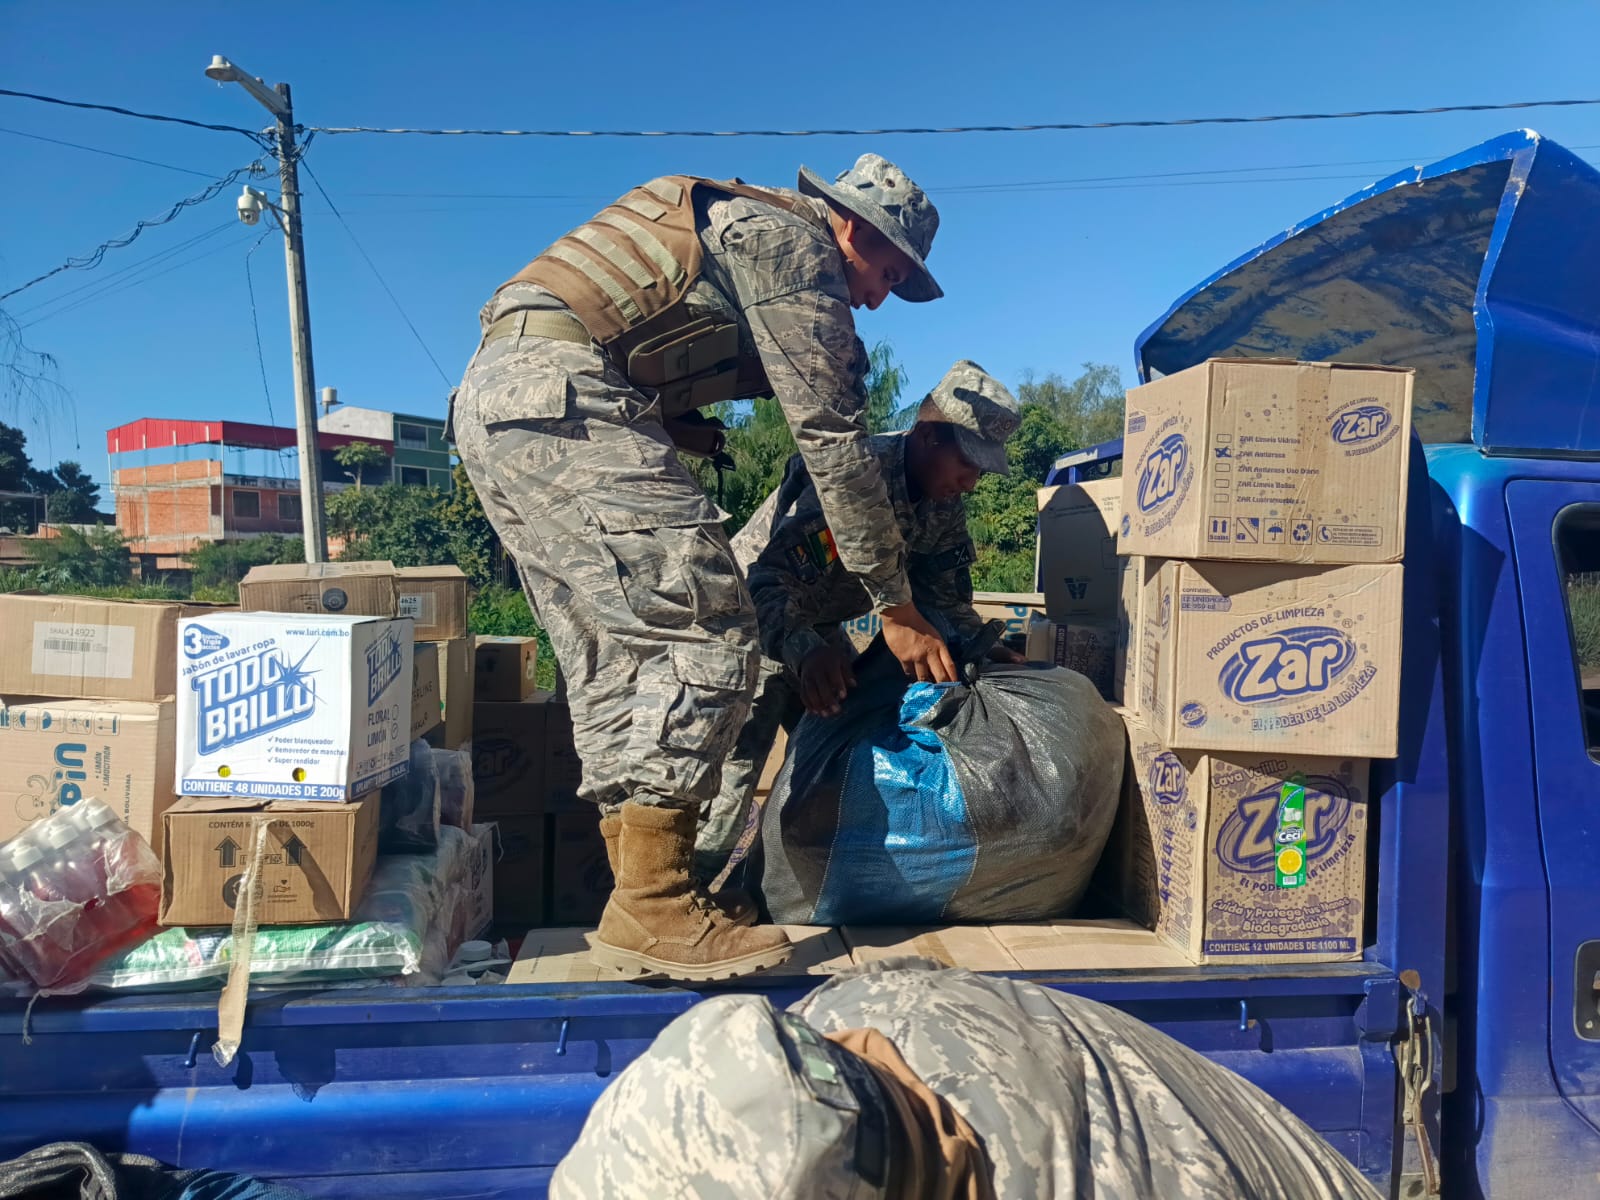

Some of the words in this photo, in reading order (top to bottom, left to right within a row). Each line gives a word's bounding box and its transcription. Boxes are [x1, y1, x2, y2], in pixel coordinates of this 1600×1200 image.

[1338, 412, 1385, 442] Zar
[1142, 446, 1182, 511] Zar
[185, 628, 203, 654] 3
[1206, 620, 1259, 660] PRODUCTOS
[1260, 613, 1275, 626] DE
[1275, 607, 1325, 621] LIMPIEZA
[212, 652, 225, 665] de
[226, 645, 250, 660] lavar
[252, 638, 276, 652] ropa
[197, 648, 285, 709] TODO
[1236, 639, 1341, 701] Zar
[204, 676, 316, 746] BRILLO
[1269, 713, 1304, 730] PODER
[1305, 707, 1320, 721] DE
[1320, 701, 1338, 715] LA
[1335, 666, 1378, 707] LIMPIEZA
[183, 780, 234, 793] CONTIENE
[235, 782, 248, 793] 48
[251, 783, 301, 796] UNIDADES
[304, 785, 318, 797] DE
[320, 786, 345, 799] 200g
[1155, 760, 1181, 794] Zar
[1211, 769, 1244, 788] Lava
[1244, 760, 1288, 778] Vajilla
[209, 819, 244, 829] CONTÉM
[292, 820, 315, 829] 1000g
[1235, 793, 1335, 862] Zr
[1240, 877, 1250, 886] EL
[1307, 871, 1318, 880] LA
[1319, 833, 1356, 872] LIMPIEZA
[1212, 899, 1244, 915] Cuida
[1245, 907, 1254, 919] y
[1255, 907, 1301, 922] Protege
[1303, 905, 1321, 916] tus
[1242, 916, 1330, 937] Biodegradable
[1209, 943, 1250, 952] CONTIENE
[1252, 942, 1262, 950] 12
[1264, 941, 1305, 951] UNIDADES
[1306, 941, 1317, 950] DE
[1319, 940, 1337, 949] 1100
[1339, 940, 1351, 949] ML
